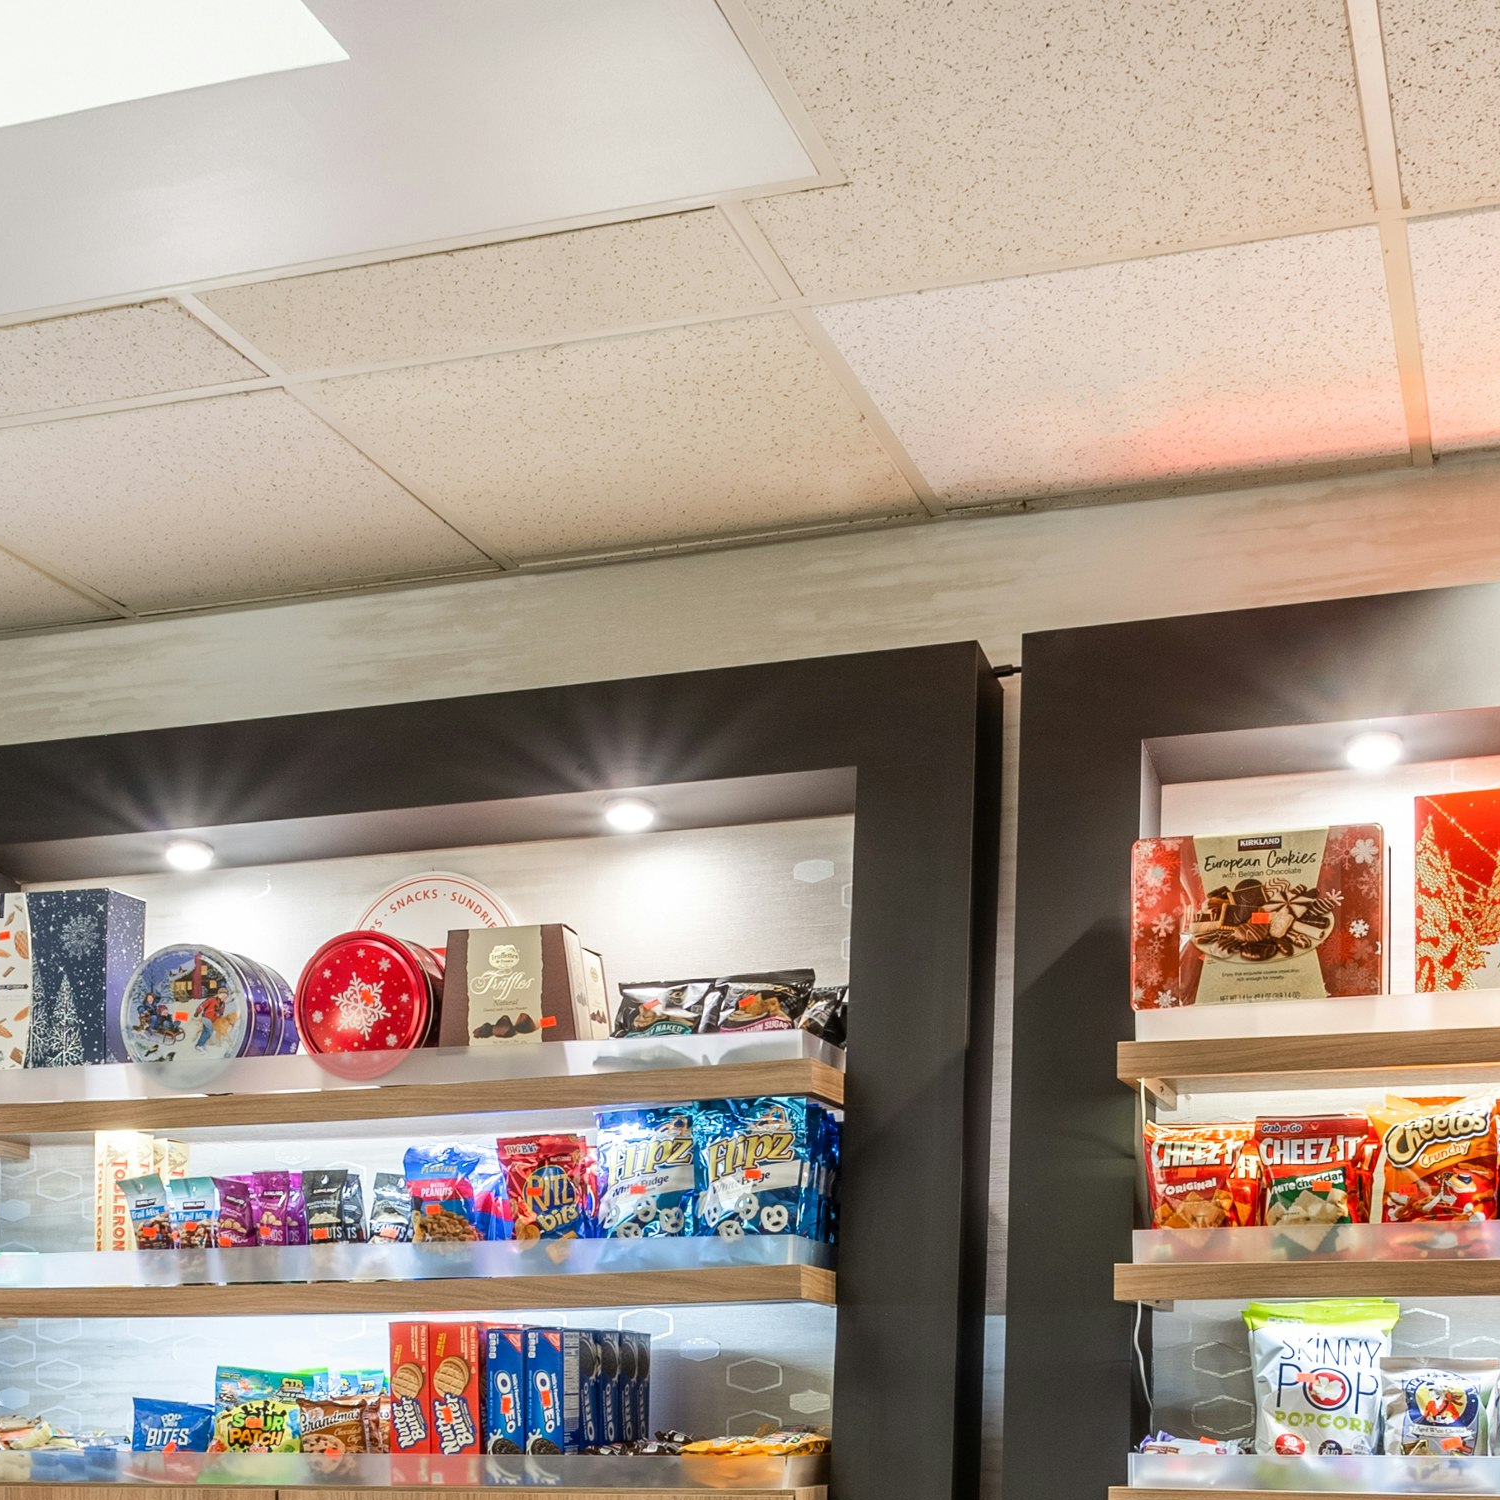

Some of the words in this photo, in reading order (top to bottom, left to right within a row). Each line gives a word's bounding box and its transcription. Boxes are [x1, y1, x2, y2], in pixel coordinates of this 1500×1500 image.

[1239, 838, 1281, 847] KIRKLAND
[1204, 855, 1260, 872] European
[1267, 850, 1317, 868] Cookies
[1238, 869, 1264, 879] Belgian
[1266, 866, 1302, 875] Chocolate
[389, 889, 439, 914] SNACKS
[471, 969, 536, 1001] Truffles
[1262, 1123, 1280, 1132] Grab
[1289, 1123, 1301, 1132] Go
[1385, 1111, 1490, 1167] Cheetos
[608, 1137, 695, 1188] Flipz
[708, 1132, 795, 1183] Flipz
[1419, 1141, 1471, 1168] Crunchy
[420, 1187, 453, 1198] PEANUTS
[641, 1174, 670, 1188] Fudge
[131, 1210, 146, 1220] Trail
[146, 1208, 161, 1218] Mix
[178, 1213, 194, 1222] Trail
[194, 1211, 208, 1220] Mix
[537, 1203, 579, 1232] bits
[1280, 1333, 1383, 1368] SKINNY
[1276, 1363, 1379, 1415] POP
[232, 1412, 284, 1432] SUR
[401, 1396, 426, 1441] Butter
[445, 1393, 475, 1447] Butter
[583, 1382, 595, 1441] OREO
[605, 1384, 615, 1441] OREO
[624, 1384, 633, 1441] OREO
[638, 1384, 647, 1438] OREO
[1275, 1410, 1375, 1436] POPCORN
[145, 1428, 191, 1448] BITES
[228, 1429, 283, 1448] PATCH
[392, 1402, 415, 1449] Nutter
